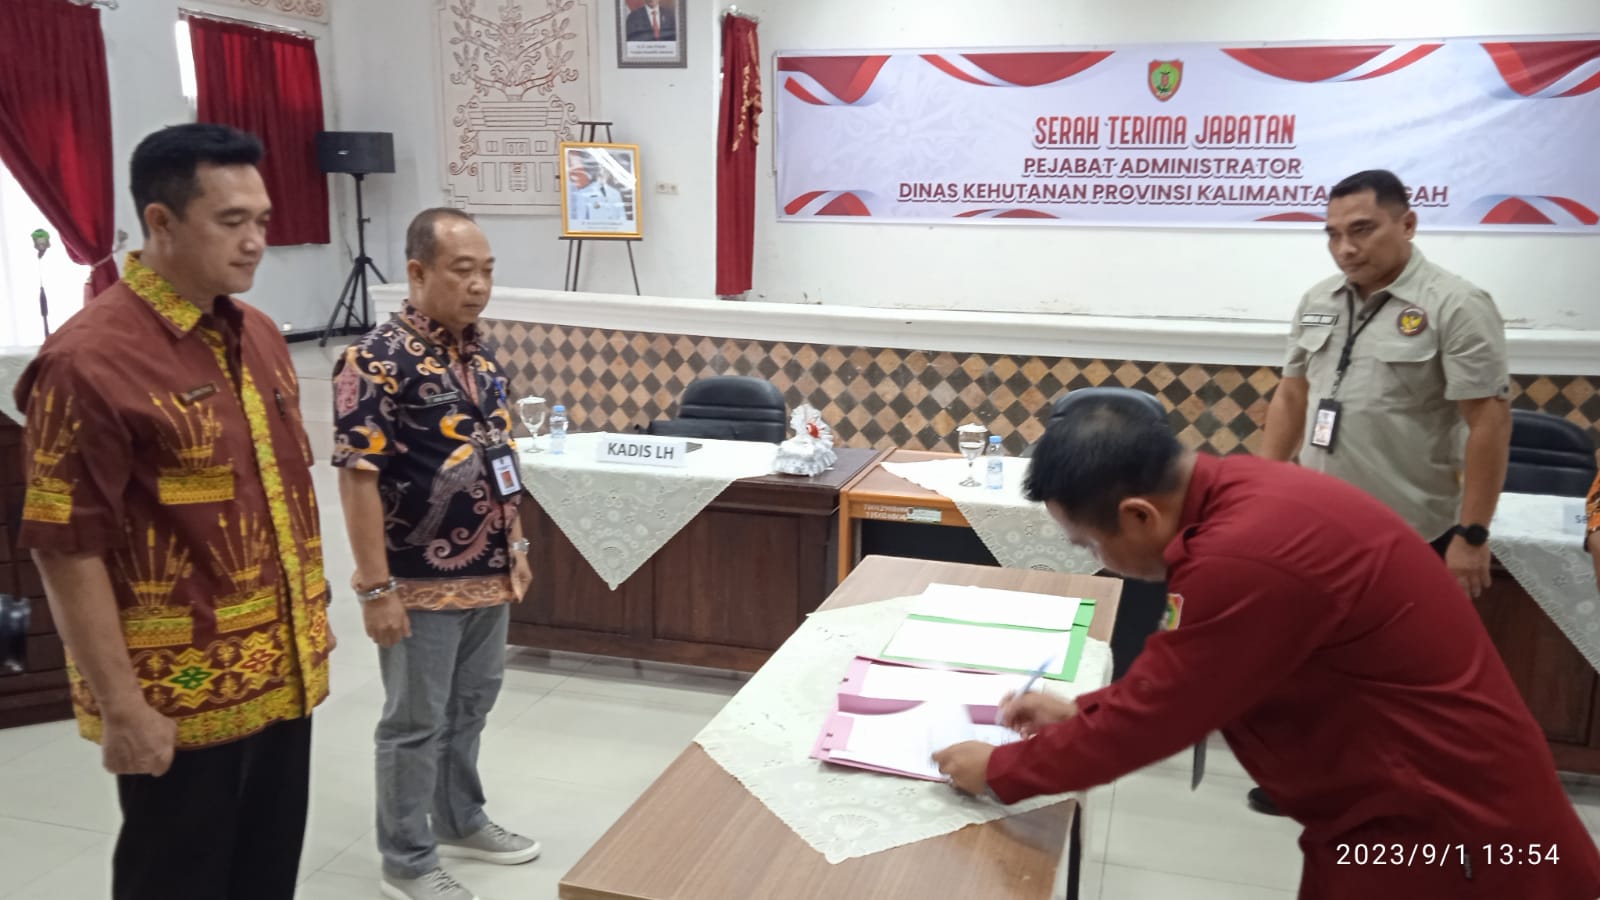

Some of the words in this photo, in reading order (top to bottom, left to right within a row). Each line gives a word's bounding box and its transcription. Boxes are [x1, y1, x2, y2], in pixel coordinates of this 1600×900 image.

[1034, 115, 1100, 146] SERAH
[1107, 115, 1188, 146] TERIMA
[1195, 114, 1296, 146] JABATAN
[1023, 157, 1116, 175] PEJABAT
[1120, 157, 1302, 175] ADMINISTRATOR
[898, 183, 958, 199] DINAS
[963, 183, 1087, 200] KEHUTANAN
[1092, 184, 1192, 201] PROVINSI
[1197, 184, 1334, 202] KALIMANTA
[607, 442, 652, 458] KADIS
[656, 445, 674, 460] LH
